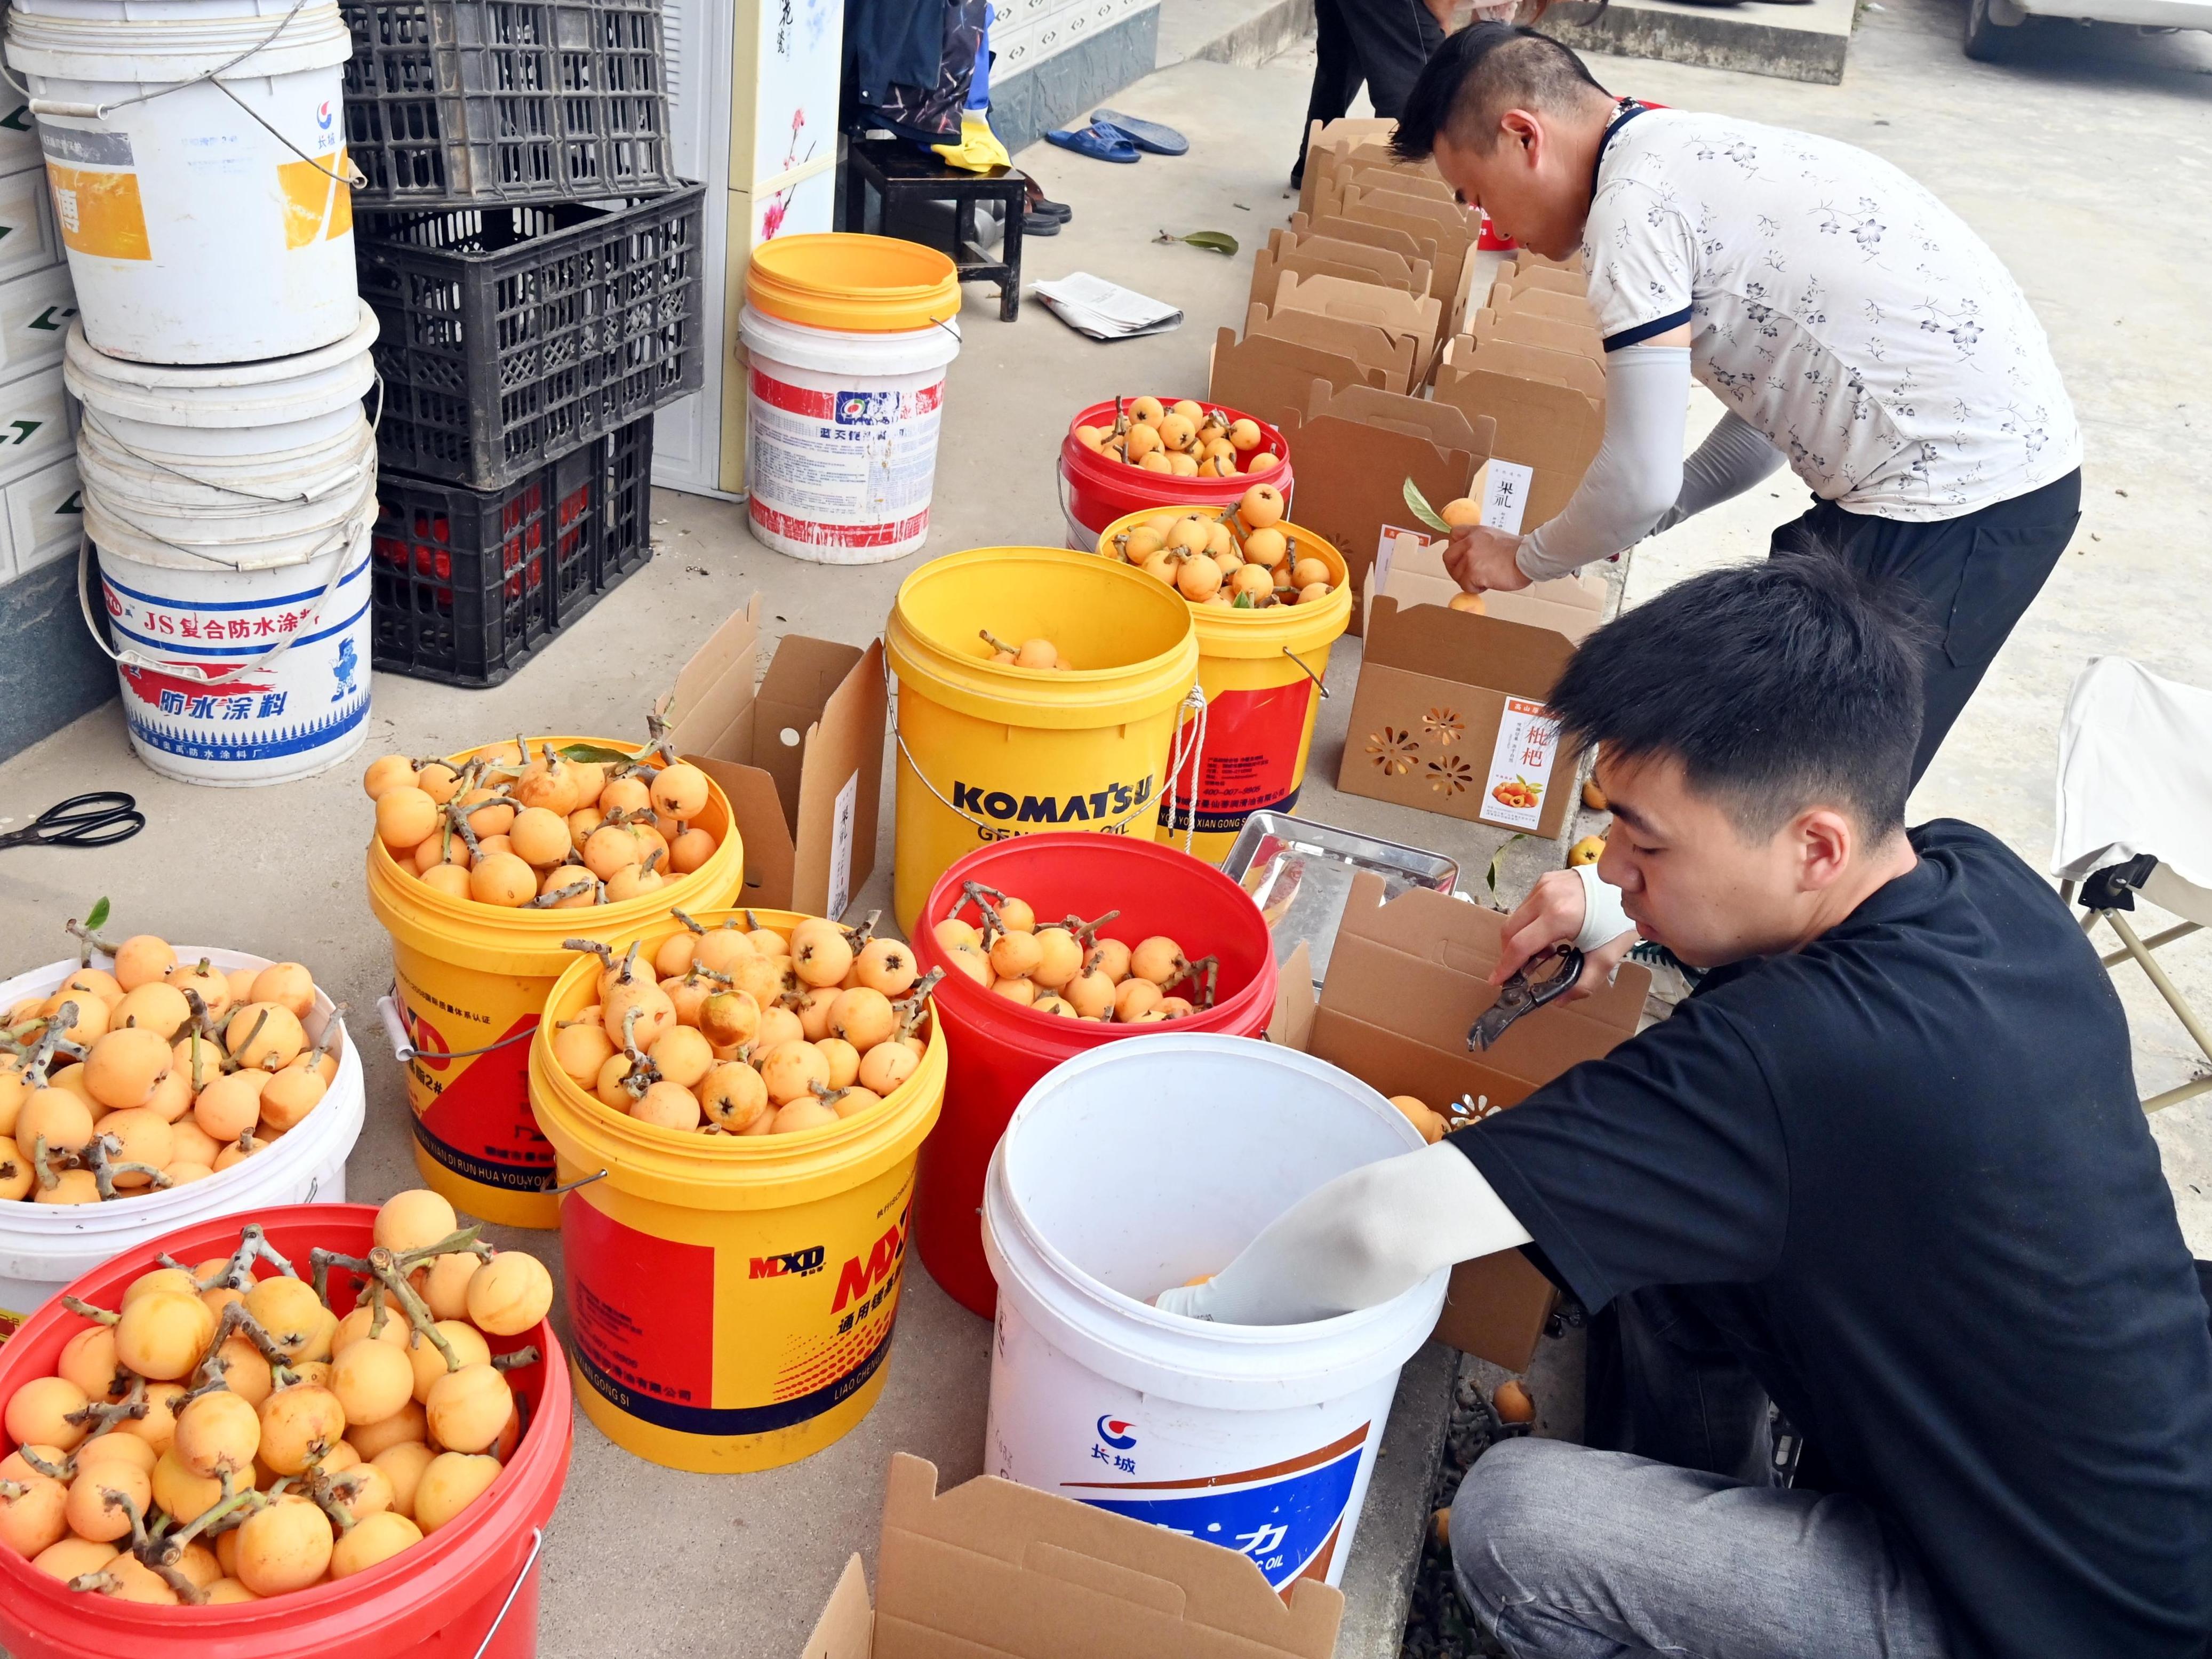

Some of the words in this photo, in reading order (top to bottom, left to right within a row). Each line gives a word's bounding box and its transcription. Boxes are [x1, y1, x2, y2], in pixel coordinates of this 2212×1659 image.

[144, 611, 174, 634] JS
[161, 690, 288, 720] 防水涂料
[1520, 725, 1548, 767] 枇杷
[953, 773, 1153, 823] KOMATSU
[1196, 818, 1216, 828] XIAN
[1217, 818, 1240, 828] GONG
[448, 1154, 456, 1168] DI
[457, 1159, 476, 1176] RUN
[478, 1167, 500, 1182] HUA
[502, 1172, 525, 1186] YOU
[748, 1245, 825, 1279] MXD
[594, 1374, 618, 1400] GONG
[620, 1394, 630, 1408] SI
[834, 1378, 855, 1400] LIAO
[1090, 1443, 1136, 1475] 长城
[1265, 1554, 1284, 1571] OIL
